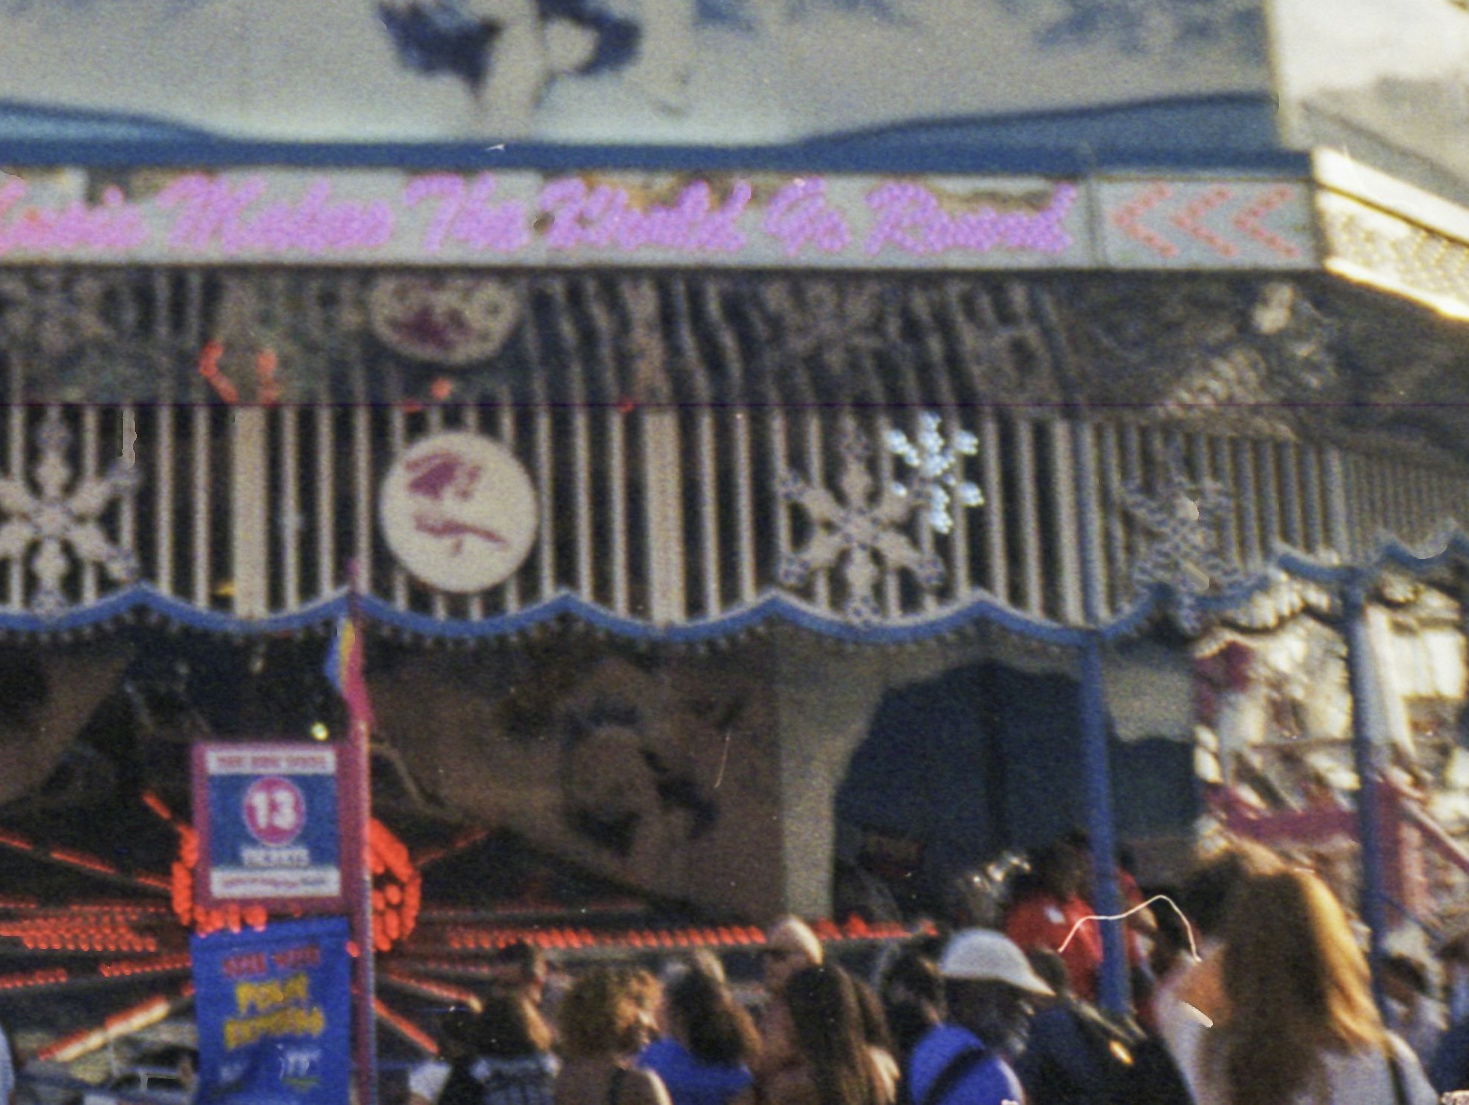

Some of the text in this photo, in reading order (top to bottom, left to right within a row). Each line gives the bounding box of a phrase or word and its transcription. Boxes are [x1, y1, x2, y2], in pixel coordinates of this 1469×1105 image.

[404, 172, 531, 252] The
[763, 175, 851, 255] Go
[251, 788, 297, 831] 13
